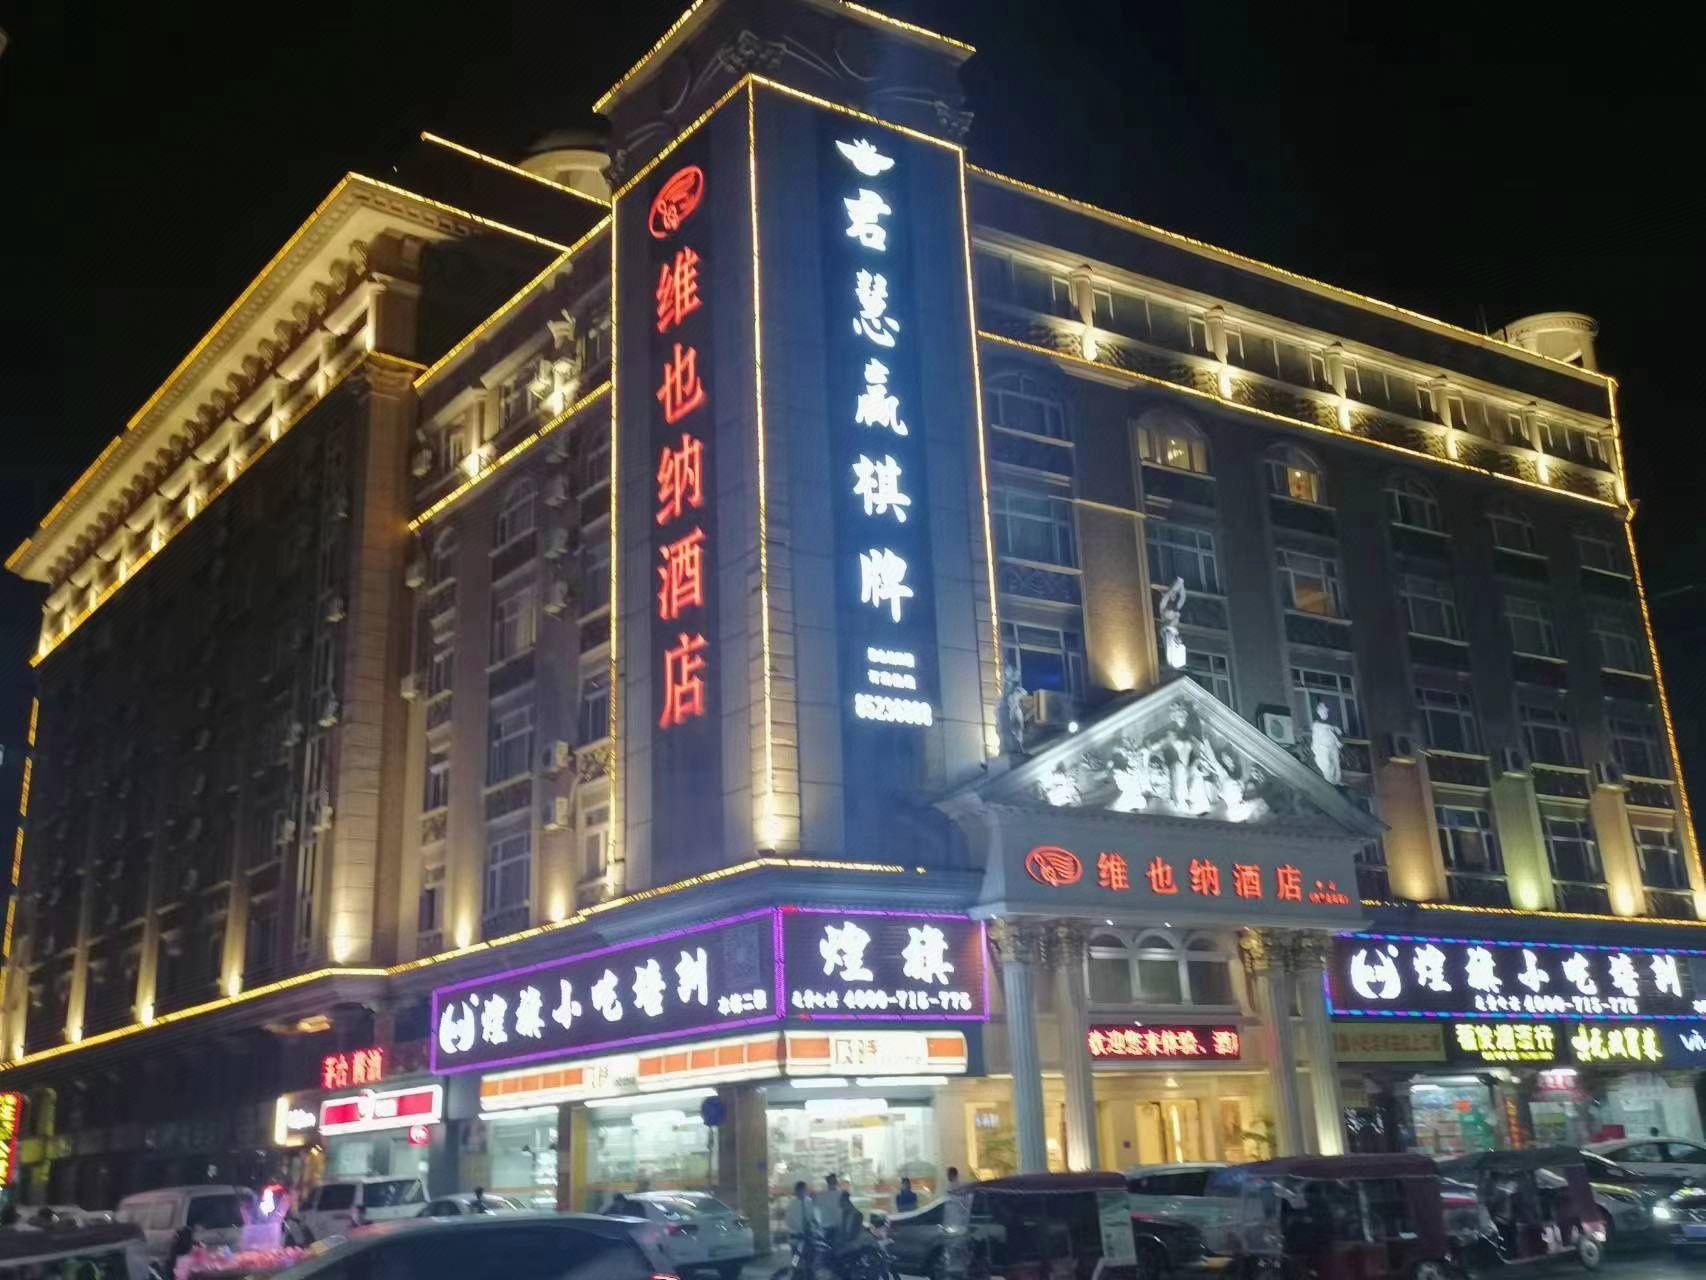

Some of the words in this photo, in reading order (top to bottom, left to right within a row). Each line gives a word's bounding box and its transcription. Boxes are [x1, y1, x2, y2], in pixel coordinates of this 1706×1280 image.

[655, 246, 707, 729] 维也纳酒店
[1096, 851, 1302, 901] 维也纳酒店
